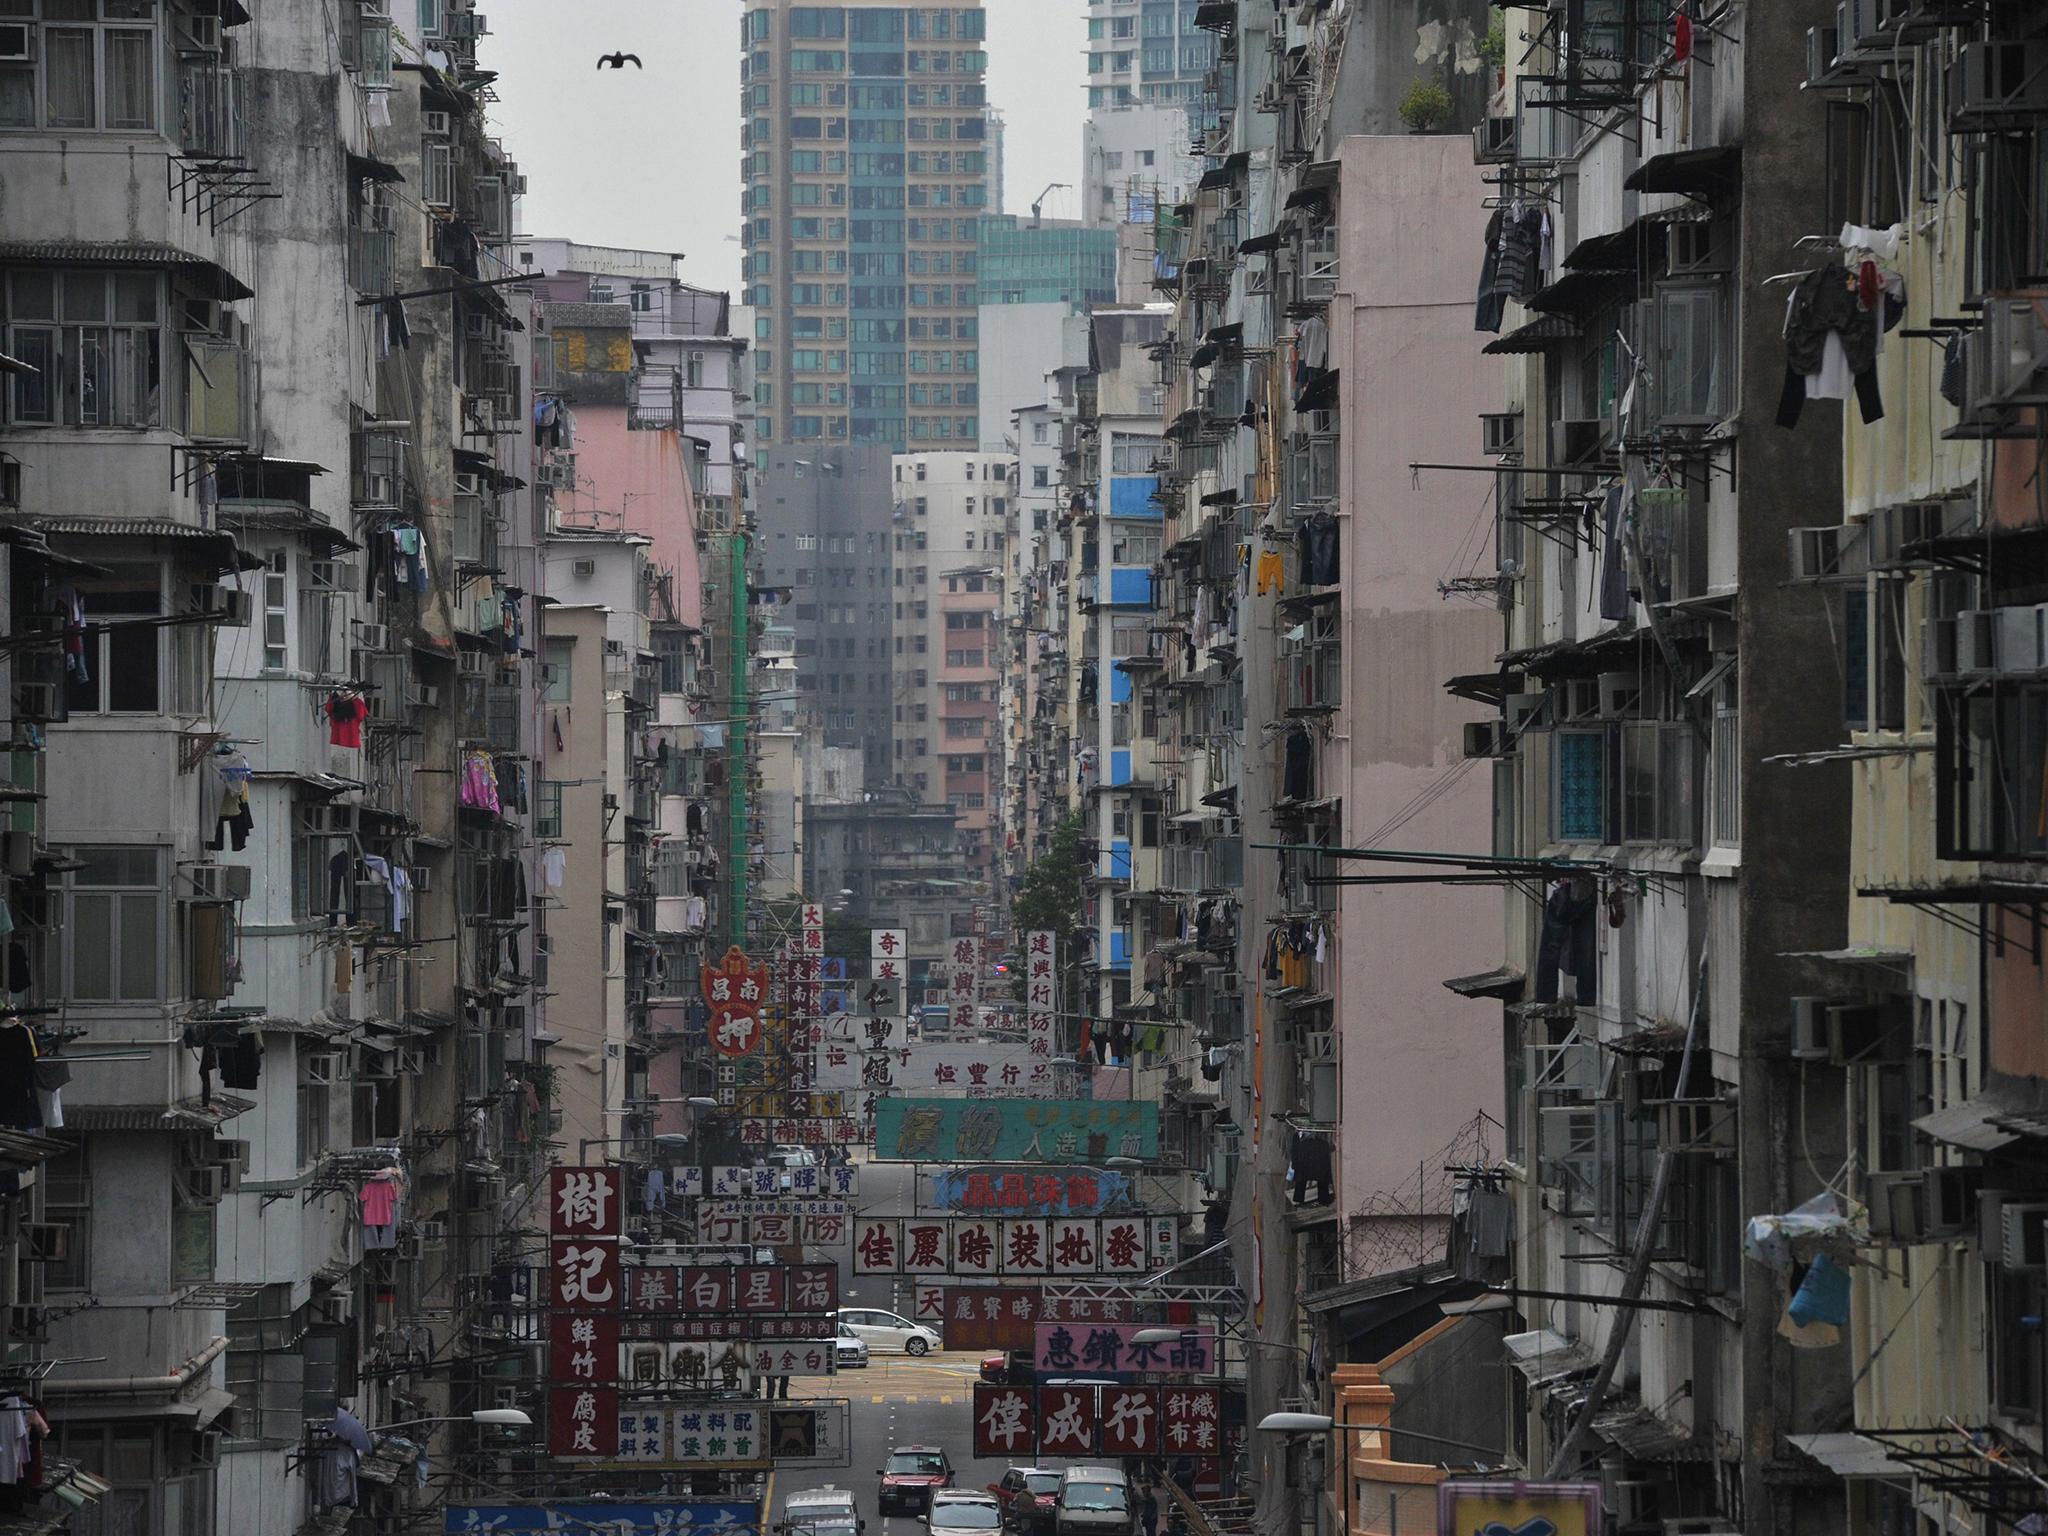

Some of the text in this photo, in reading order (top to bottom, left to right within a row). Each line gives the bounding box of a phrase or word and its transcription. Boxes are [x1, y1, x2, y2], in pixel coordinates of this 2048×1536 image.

[712, 977, 760, 1001] 南昌
[953, 939, 976, 1043] 德興疋
[716, 1011, 755, 1050] 押
[963, 1173, 1099, 1209] 晶晶珠飾
[556, 1172, 614, 1303] 樹記
[635, 1270, 831, 1311] 福星白藥
[571, 1318, 598, 1452] 鮮竹腐皮
[979, 1391, 1154, 1450] 偉成行
